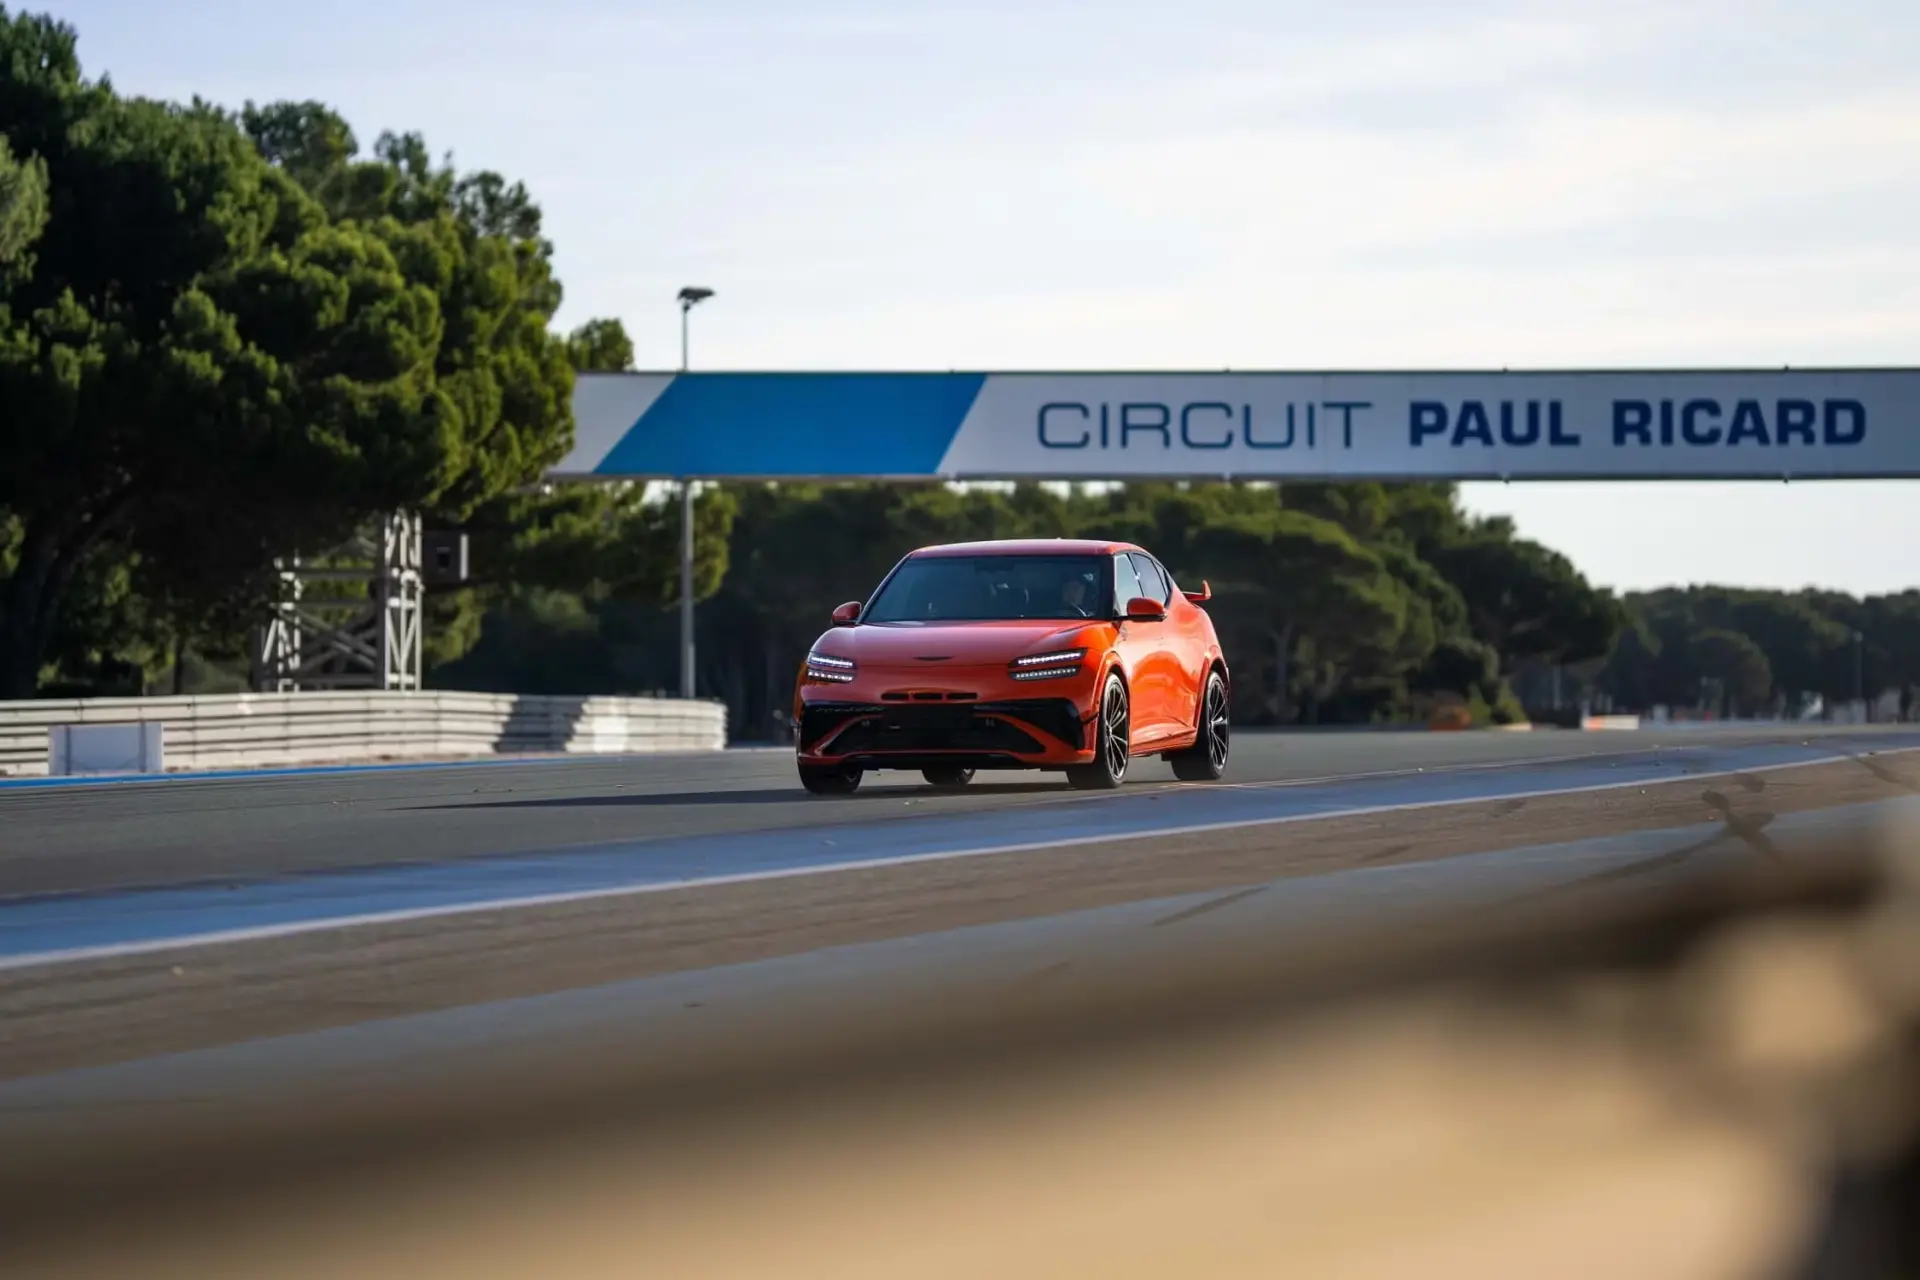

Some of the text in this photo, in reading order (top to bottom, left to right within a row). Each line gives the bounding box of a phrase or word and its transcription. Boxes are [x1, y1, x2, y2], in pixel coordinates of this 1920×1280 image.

[1037, 398, 1866, 449] CIRCUIT PAUL RICARD
